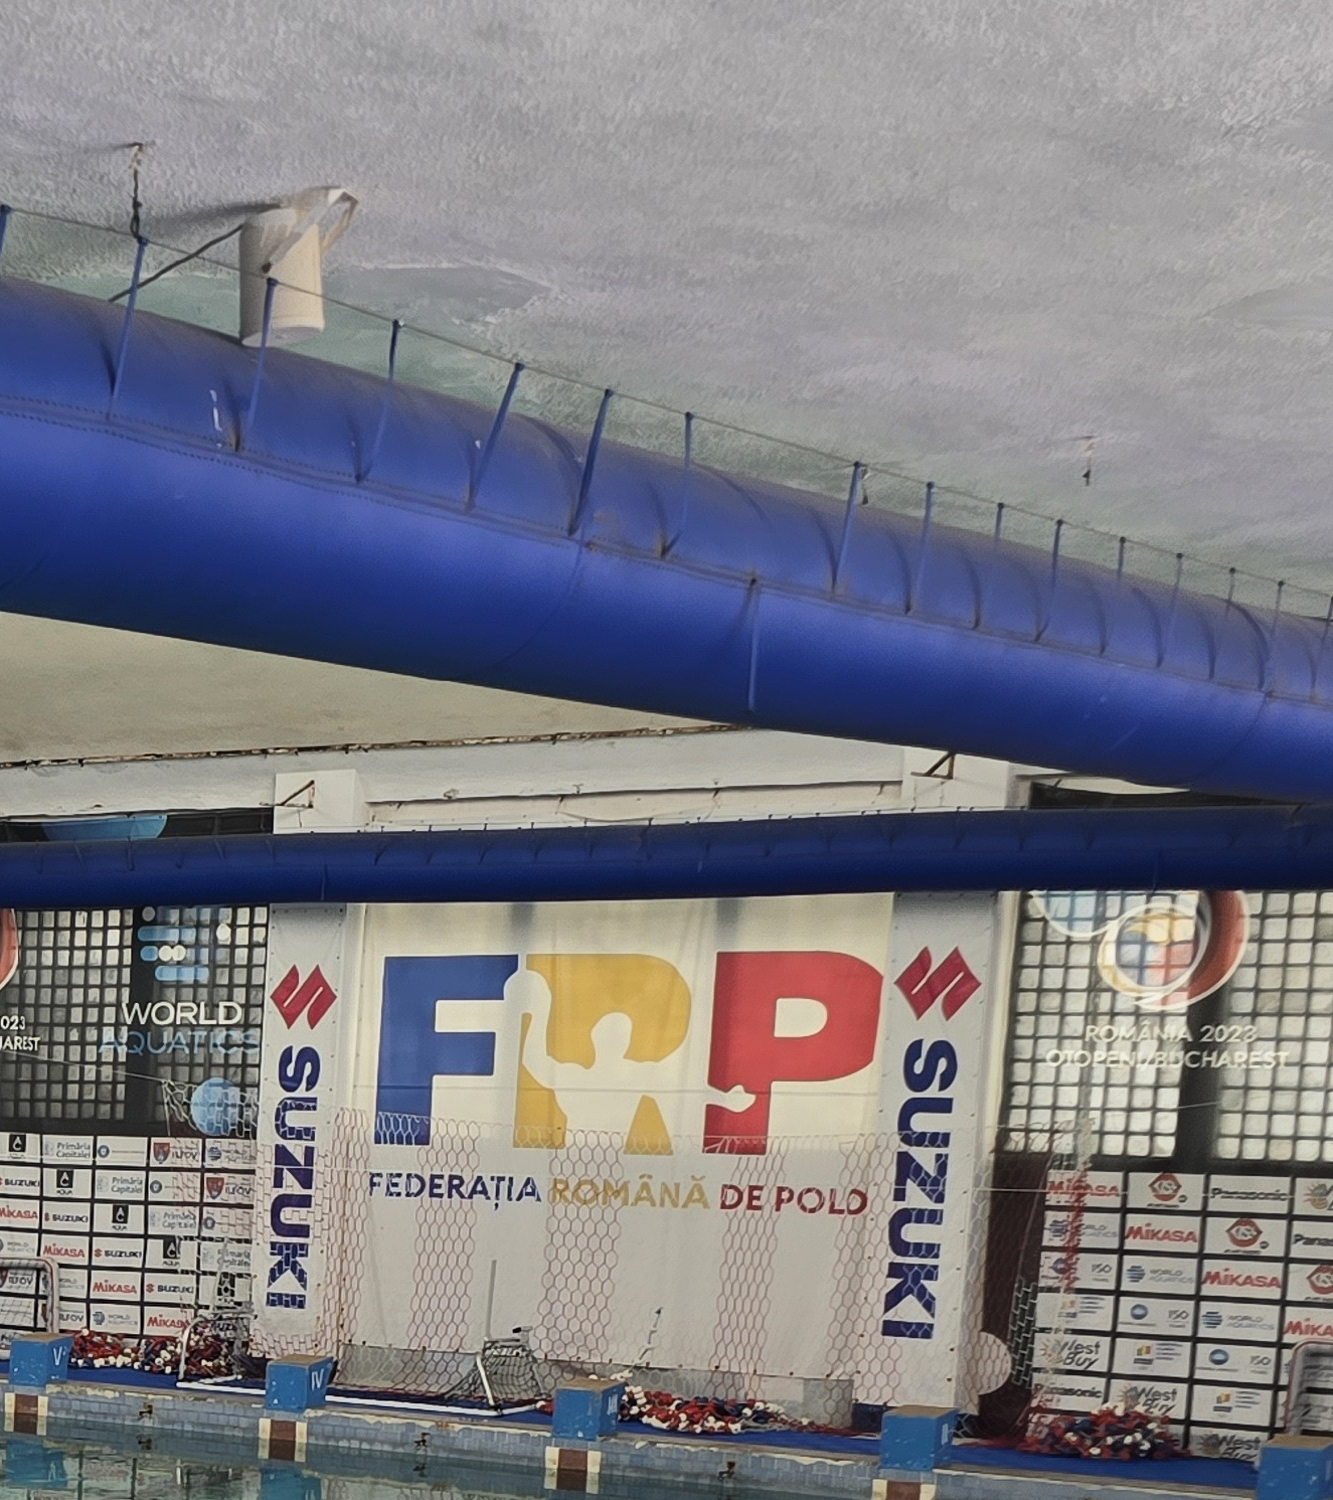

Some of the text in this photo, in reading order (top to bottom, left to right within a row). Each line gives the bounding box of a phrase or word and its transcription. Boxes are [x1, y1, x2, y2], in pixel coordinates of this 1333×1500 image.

[121, 1001, 243, 1026] WORLD
[98, 1029, 261, 1054] AQUATICS
[1085, 1019, 1258, 1043] ROMÂNIA 2023
[4, 1177, 40, 1187] SUZUKI
[265, 1045, 321, 1309] SUZUKI
[719, 1183, 765, 1212] DE
[775, 1185, 869, 1216] POLO
[881, 1038, 958, 1339] SUZUKI
[52, 1214, 88, 1223] SUZUKI
[104, 1250, 142, 1258] SUZUKI
[157, 1285, 194, 1294] SUZUKI
[1062, 1351, 1100, 1370] Buy
[311, 1369, 324, 1391] IV
[1137, 1386, 1178, 1401] West
